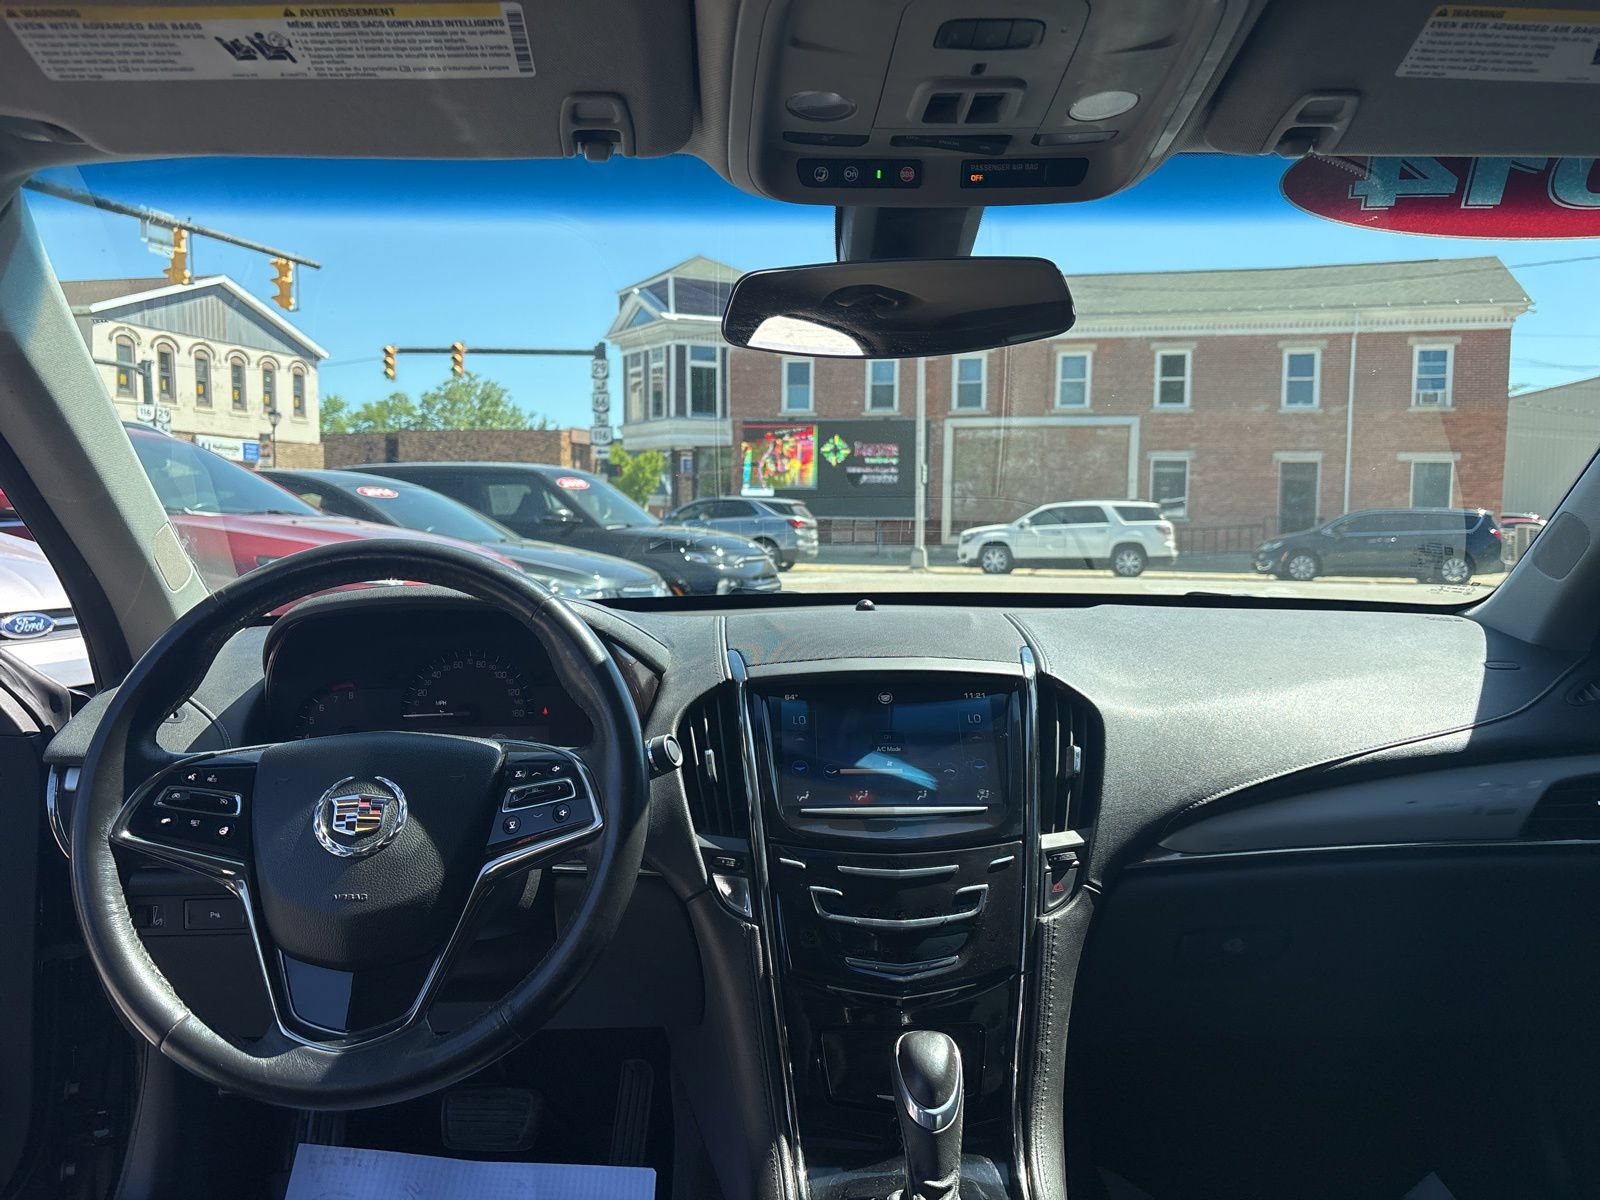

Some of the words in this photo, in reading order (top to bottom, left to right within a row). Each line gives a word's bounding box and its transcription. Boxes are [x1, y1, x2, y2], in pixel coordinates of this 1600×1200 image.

[299, 8, 396, 17] AVERTISSEMENT
[14, 22, 46, 30] EVEN
[49, 22, 79, 30] WITH
[82, 22, 144, 31] ADVANCED
[148, 22, 169, 30] AIR
[170, 22, 203, 30] BAGS
[362, 20, 386, 28] SACS
[386, 19, 444, 28] GONFLABLES
[444, 19, 505, 28] INTELLIGENTS
[1430, 21, 1458, 29] EVEN
[1461, 22, 1489, 30] WITH
[1490, 22, 1550, 32] ADVANCED
[970, 163, 1010, 171] PASSENGER
[970, 174, 984, 182] OFF
[159, 409, 170, 418] 29
[594, 431, 608, 442] 116
[15, 615, 45, 633] Ford
[417, 688, 428, 697] 20
[792, 715, 806, 725] LO
[967, 713, 982, 724] LO
